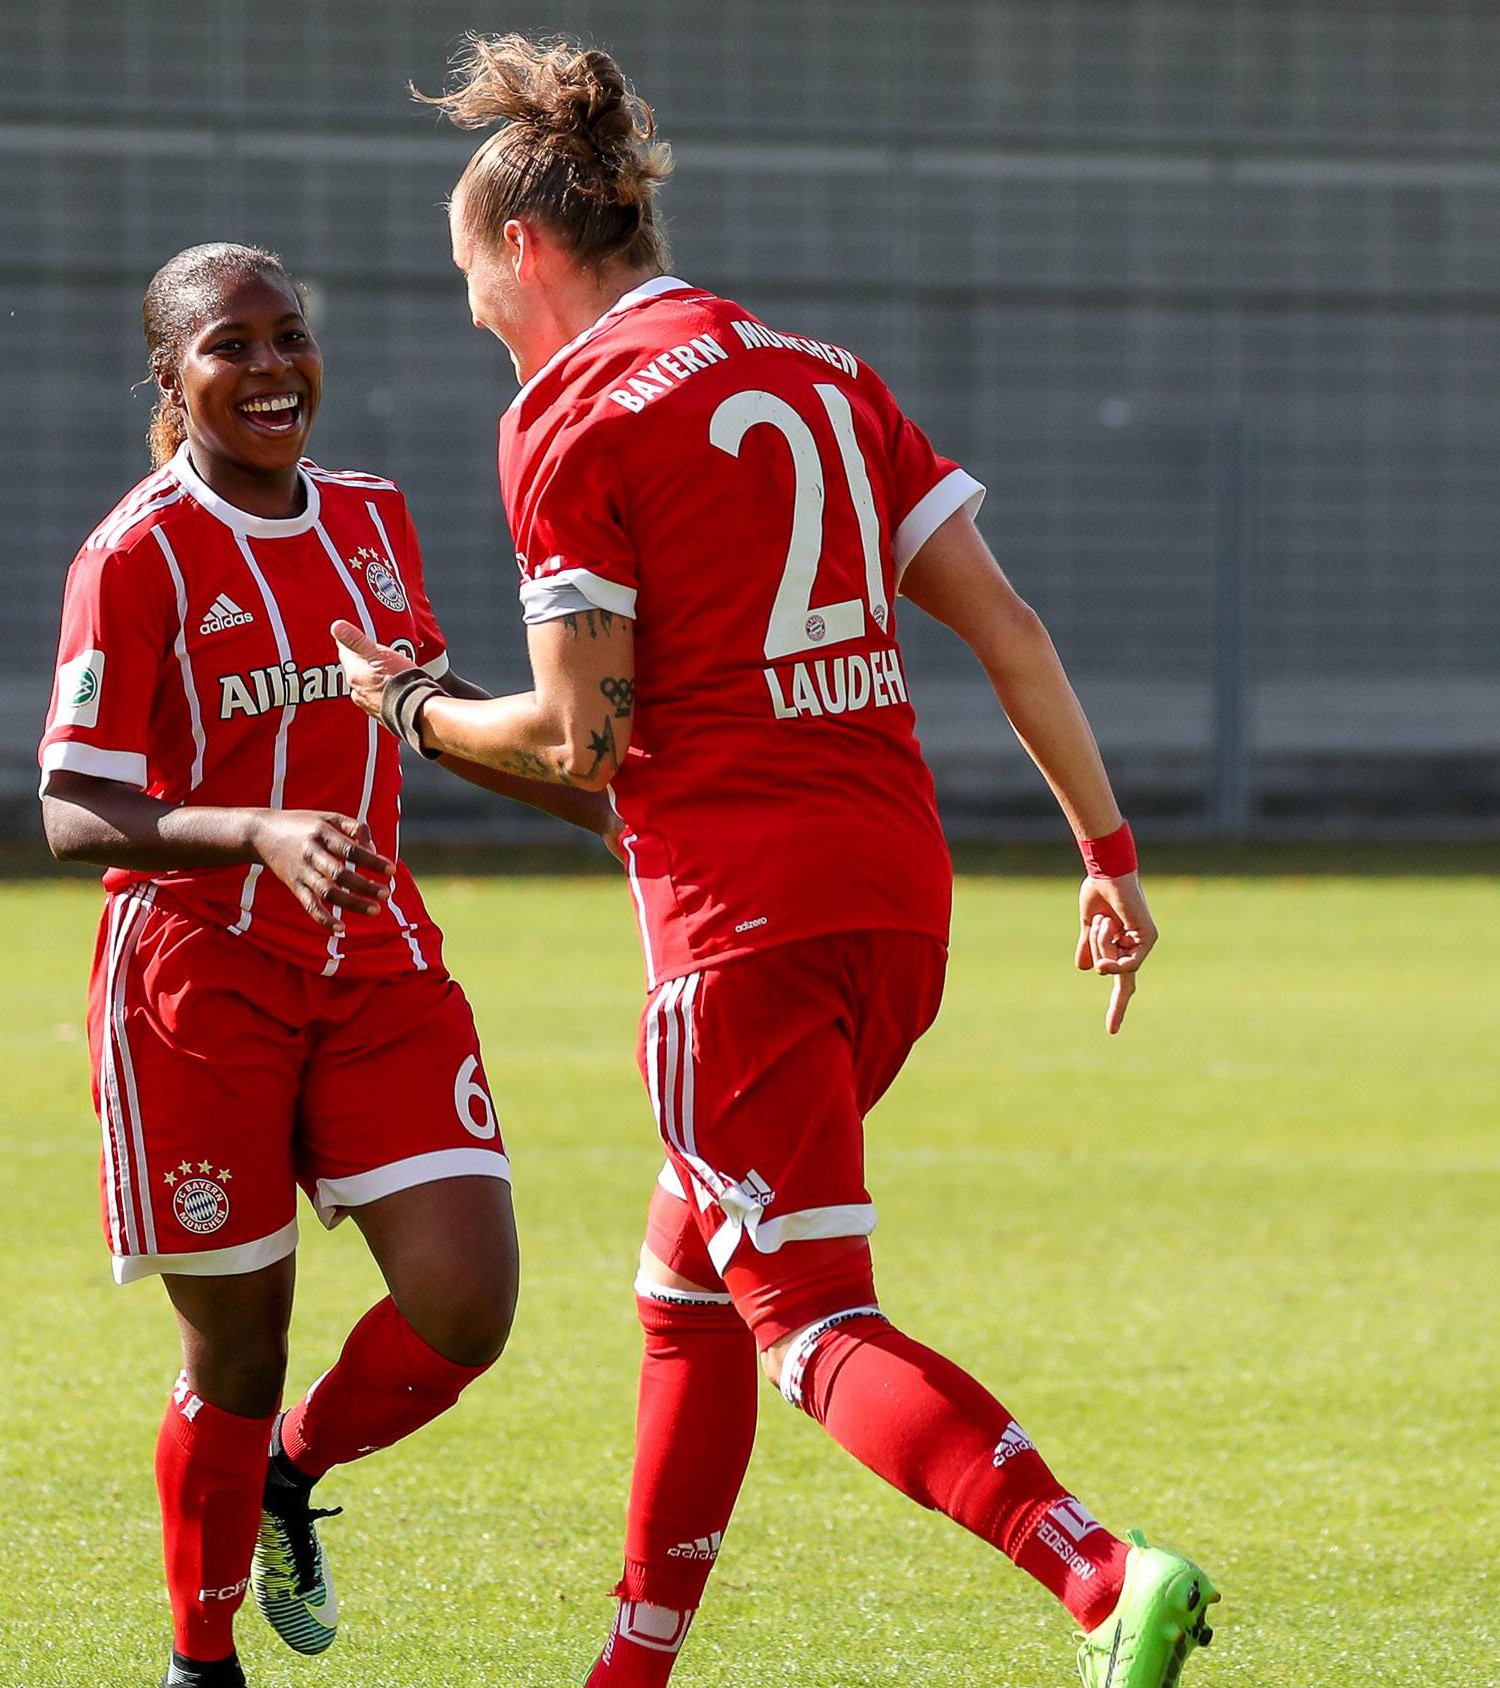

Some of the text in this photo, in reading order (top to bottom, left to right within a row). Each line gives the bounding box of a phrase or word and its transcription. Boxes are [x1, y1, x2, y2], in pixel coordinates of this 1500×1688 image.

[608, 333, 729, 414] BAYERN
[709, 383, 887, 660] 21
[199, 612, 254, 635] adidas
[219, 661, 351, 719] Allian
[763, 648, 908, 720] LAUDEH
[454, 1053, 496, 1140] 6
[185, 1181, 224, 1202] BAYERN
